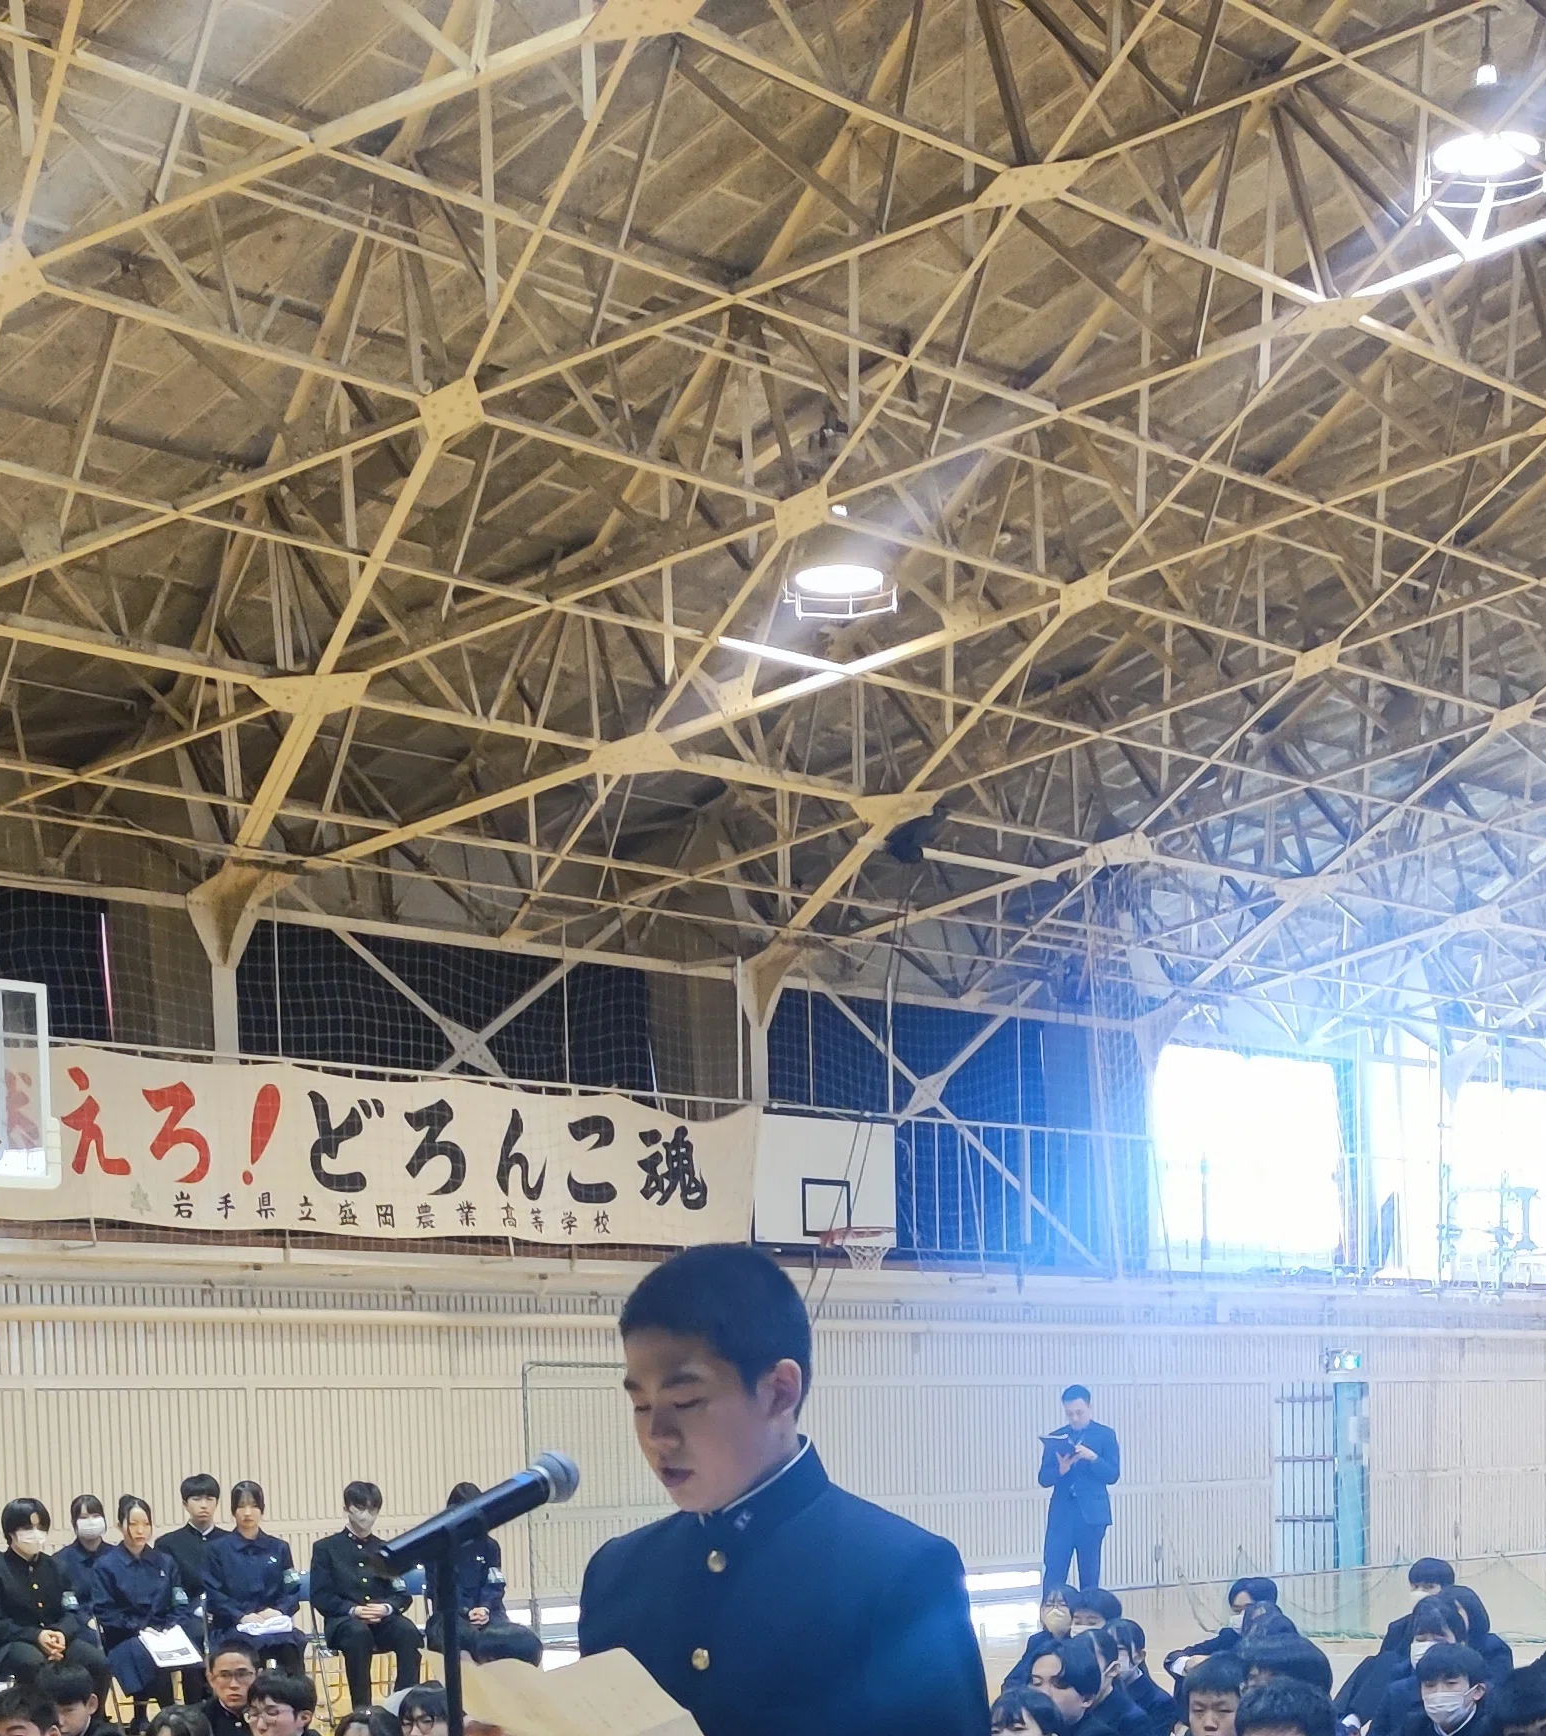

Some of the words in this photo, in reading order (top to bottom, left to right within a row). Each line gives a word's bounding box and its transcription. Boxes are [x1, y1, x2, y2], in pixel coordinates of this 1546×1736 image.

[173, 1190, 611, 1235] 岩手県立盛岡農業高等学校
